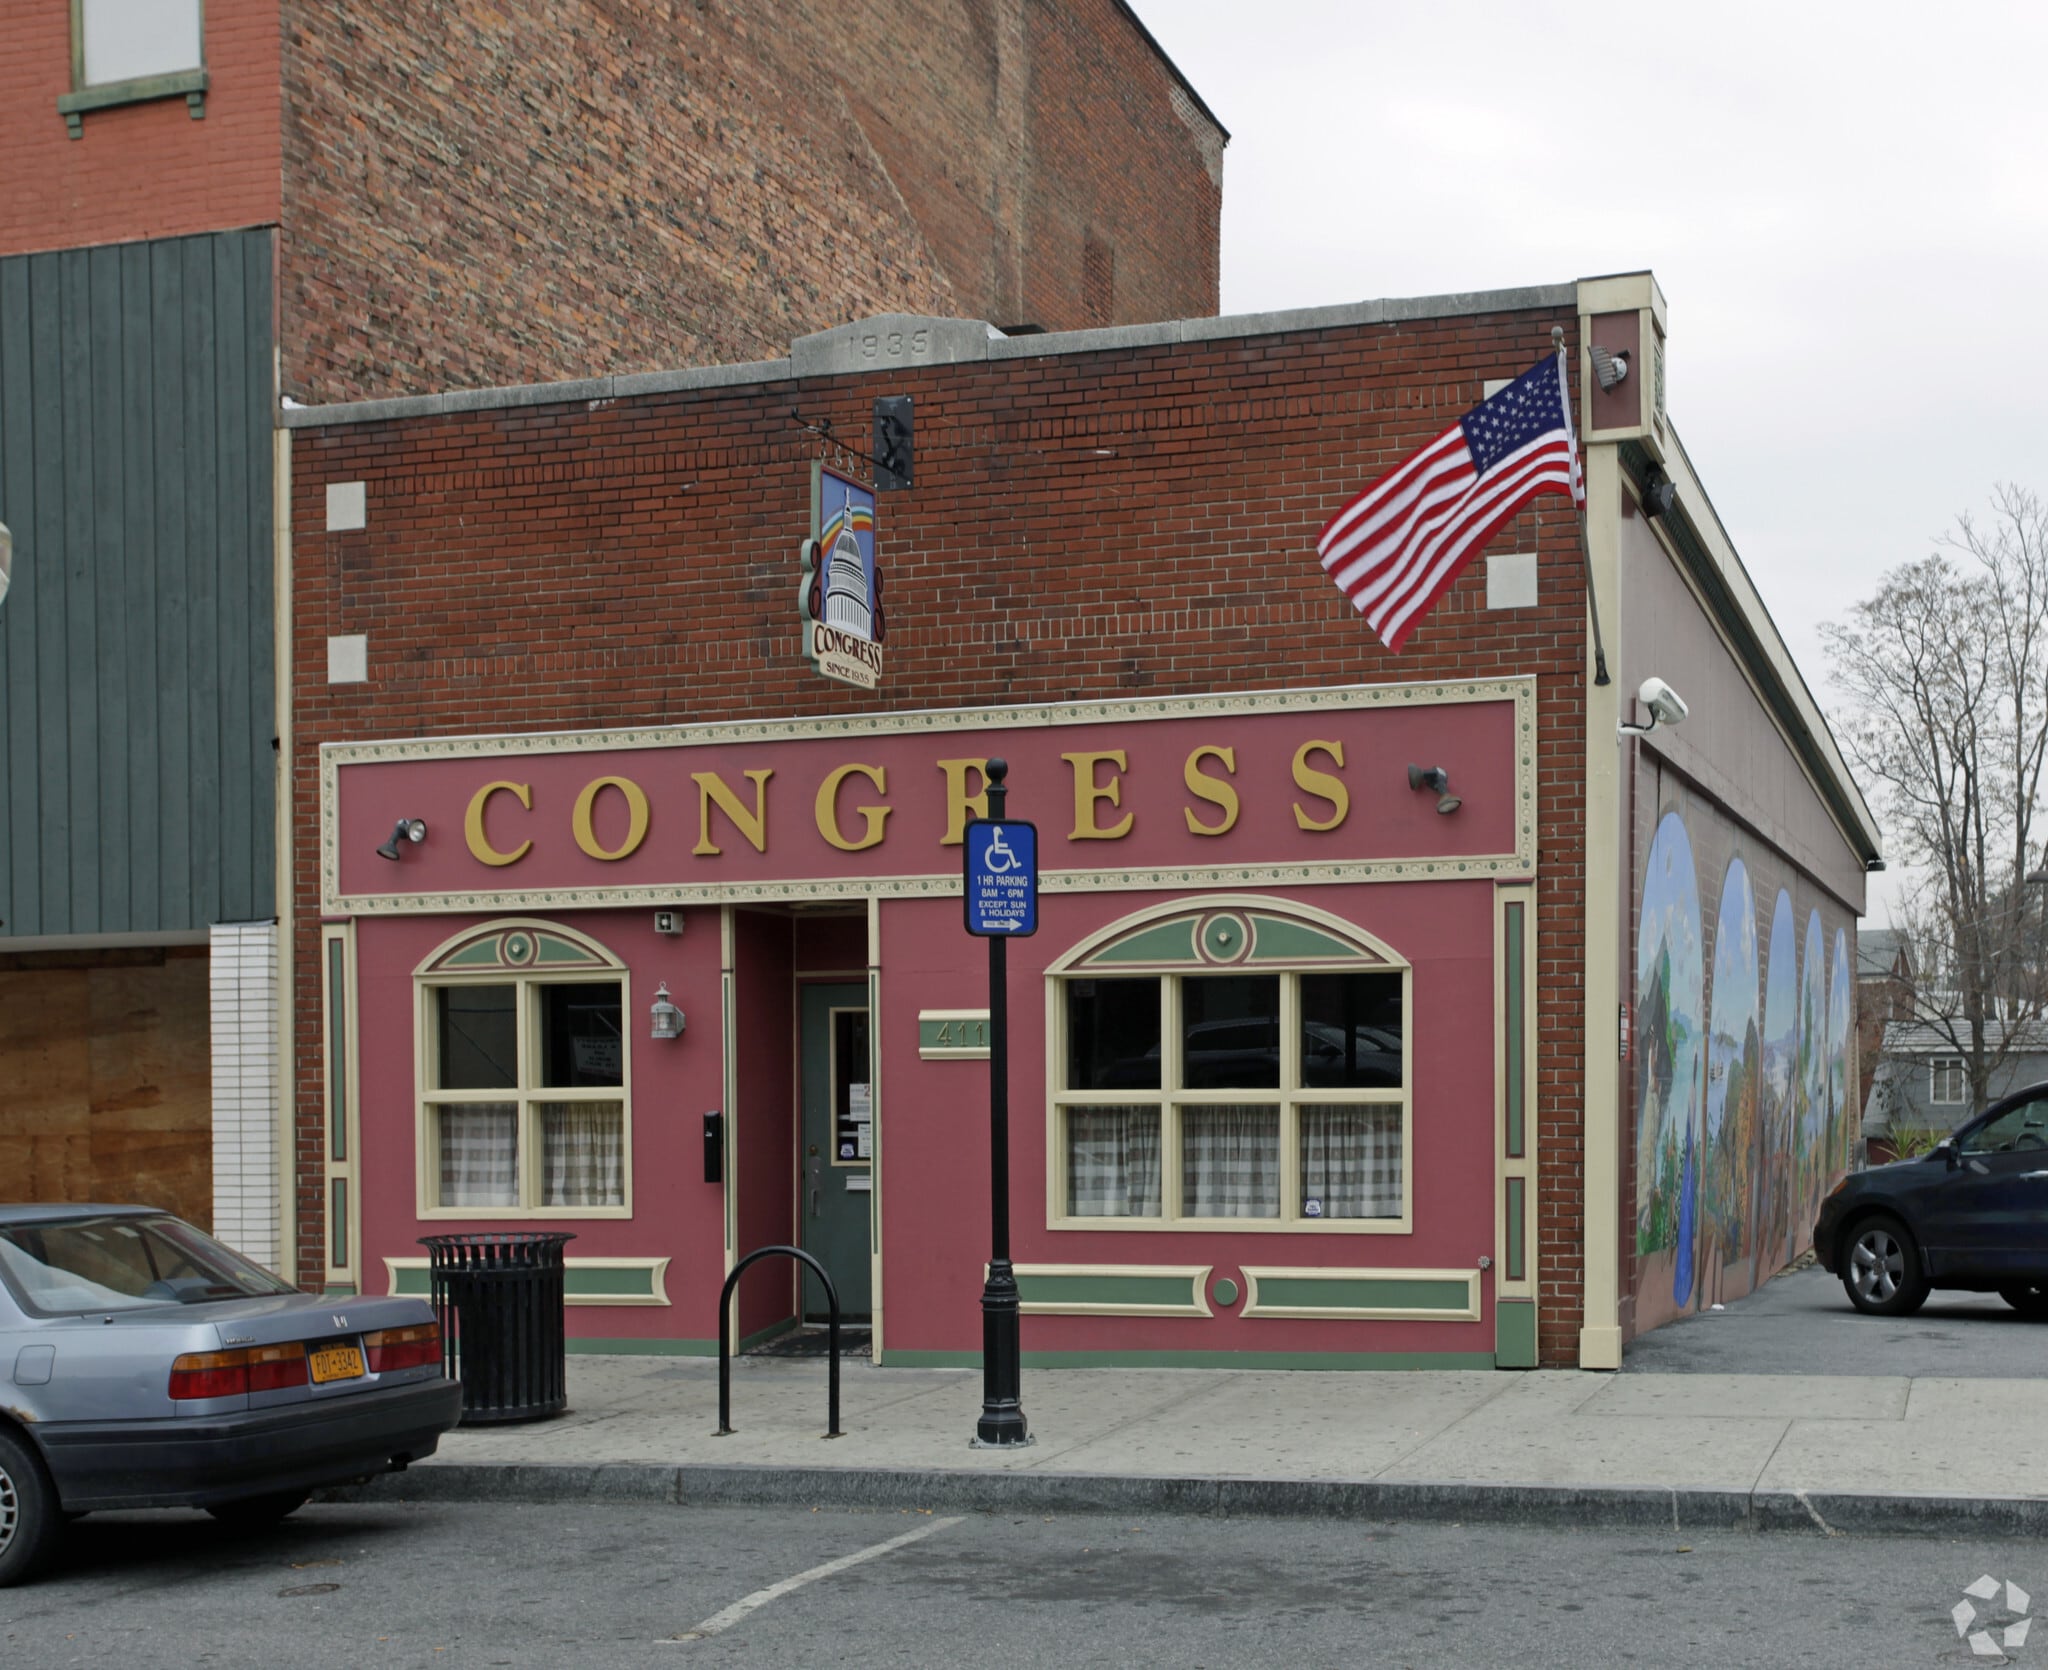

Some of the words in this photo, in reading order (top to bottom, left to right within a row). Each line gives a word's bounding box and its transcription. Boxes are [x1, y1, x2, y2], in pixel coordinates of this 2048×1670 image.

[850, 329, 927, 359] 1935
[814, 624, 881, 676] CONGRESS
[826, 661, 850, 678] SINCE
[983, 875, 994, 886] HR
[996, 875, 1028, 887] PARKING
[981, 888, 998, 898] 8AM
[1007, 888, 1024, 898] 6PM
[978, 901, 1007, 909] EXCEPT
[1010, 901, 1027, 909] SUN
[989, 909, 1025, 917] HOLIDAYS
[936, 1022, 985, 1047] 411
